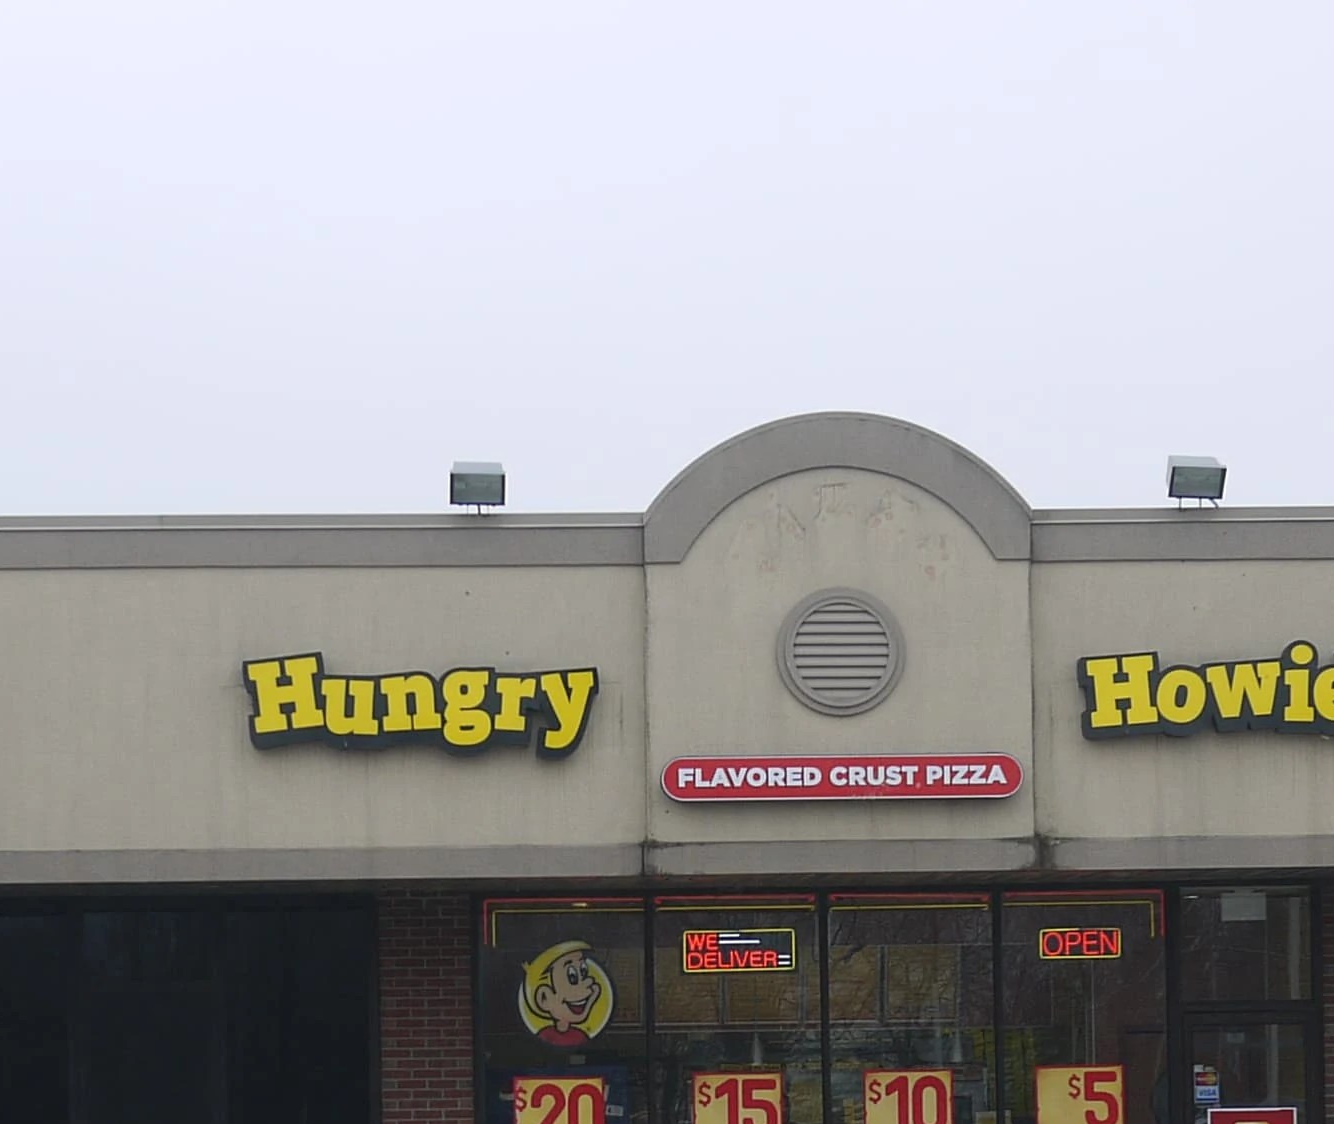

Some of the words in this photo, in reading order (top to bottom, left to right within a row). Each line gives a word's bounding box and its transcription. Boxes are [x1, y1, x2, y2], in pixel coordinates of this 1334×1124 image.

[245, 654, 597, 751] Hungry
[677, 765, 822, 789] FLAVORED
[830, 764, 918, 788] CRUST
[925, 763, 1008, 786] PIZZA
[687, 933, 719, 951] WE
[1043, 930, 1118, 956] OPEN
[687, 950, 778, 969] DELIVER
[1198, 1087, 1217, 1097] VISA
